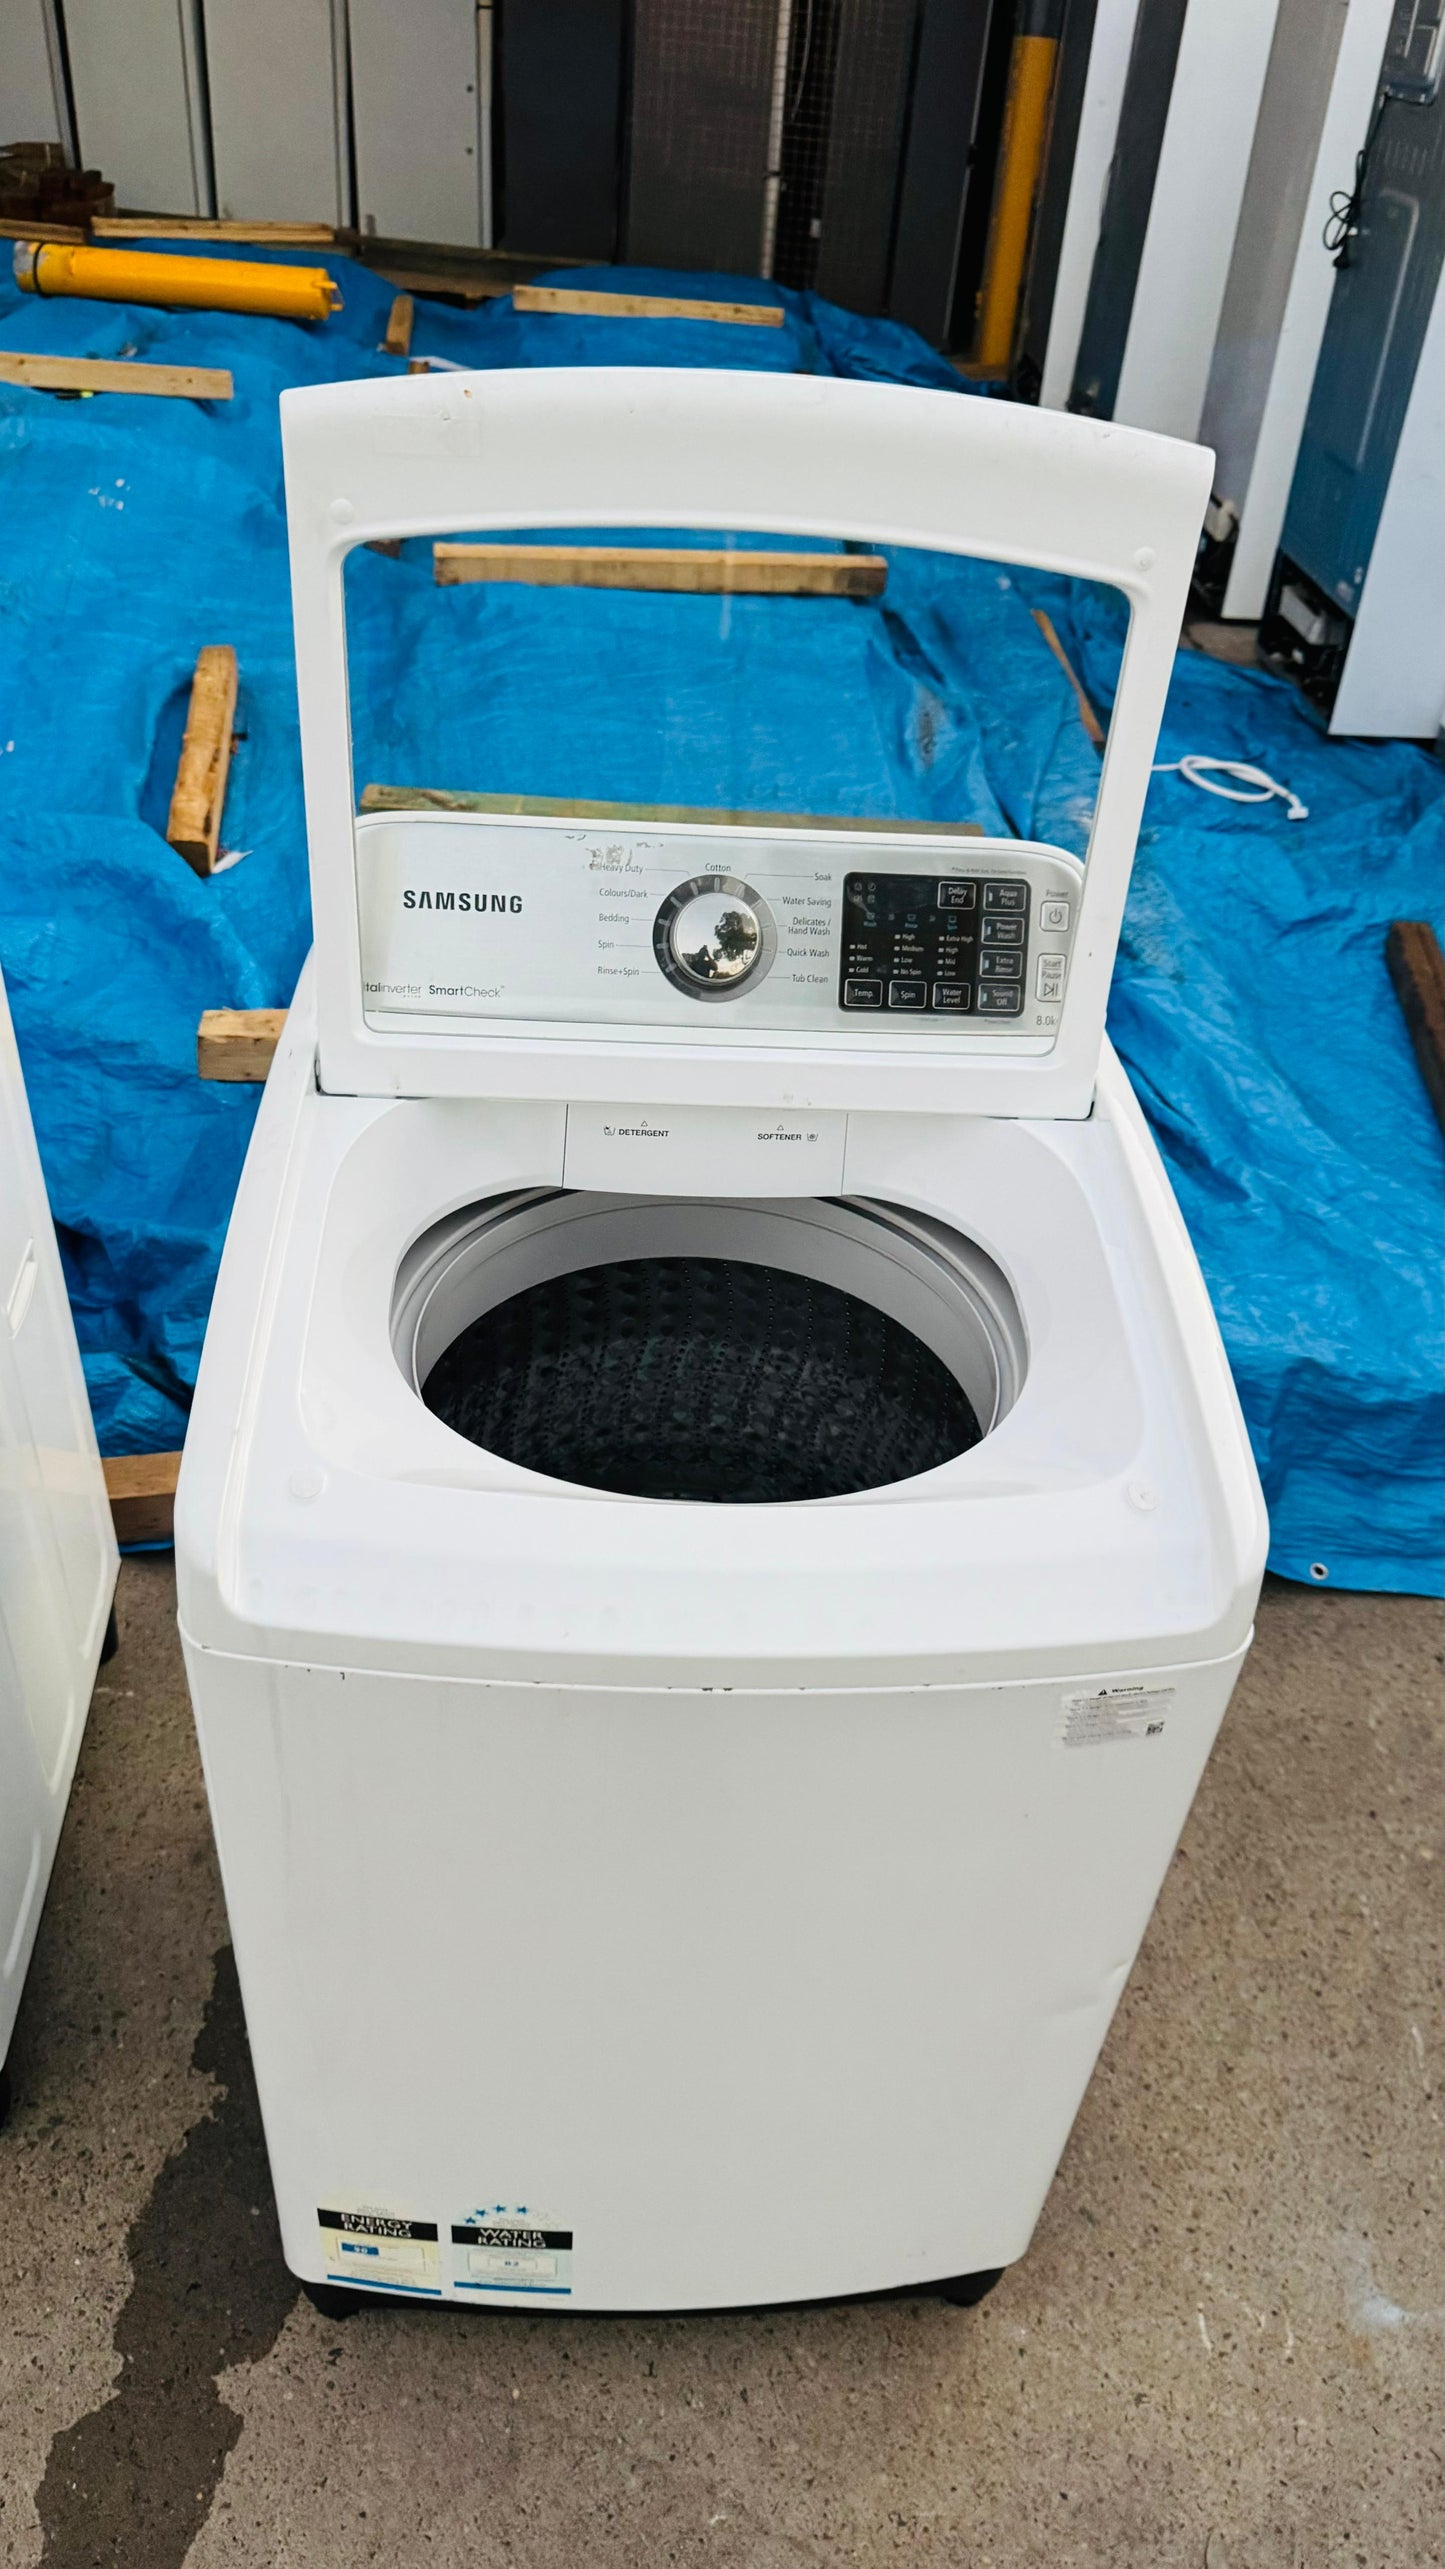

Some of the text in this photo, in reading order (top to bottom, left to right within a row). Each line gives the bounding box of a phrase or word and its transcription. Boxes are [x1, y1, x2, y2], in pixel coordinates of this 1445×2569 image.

[600, 863, 644, 875] Heavy Duty
[705, 863, 732, 872] Cotton
[814, 872, 833, 882] Soak
[599, 888, 649, 898] Colours/Dark
[948, 887, 968, 899] Delay
[1000, 889, 1018, 900] Aqua
[1046, 889, 1069, 898] Power
[403, 890, 523, 914] SAMSUNG
[783, 896, 832, 909] Water Saving
[951, 896, 965, 904] End
[1001, 897, 1016, 906] Plus
[599, 913, 630, 925] Bedding
[793, 916, 825, 926] Delicates
[788, 925, 831, 936] Hand Wash
[996, 922, 1018, 932] Power
[902, 932, 916, 941] High
[997, 930, 1017, 940] Wash
[597, 940, 615, 950] Spin
[945, 945, 959, 954] High
[787, 948, 830, 958] Quick Wash
[857, 954, 874, 962] Warm
[996, 956, 1014, 965] Extra
[1043, 959, 1063, 968] Start
[597, 966, 640, 977] Rinse+Spin
[944, 969, 957, 977] Low
[792, 974, 829, 984] Tub Clean
[900, 990, 918, 1000] Spin
[942, 988, 963, 997] Water
[992, 989, 1014, 998] Sound
[943, 996, 961, 1005] Level
[996, 997, 1008, 1006] Off
[618, 1128, 670, 1137] DETERGENT
[757, 1132, 802, 1141] SOFTENER
[341, 2213, 413, 2230] ENERGY
[343, 2221, 412, 2238] RATING
[479, 2227, 543, 2240] WATER
[477, 2235, 547, 2248] RATING
